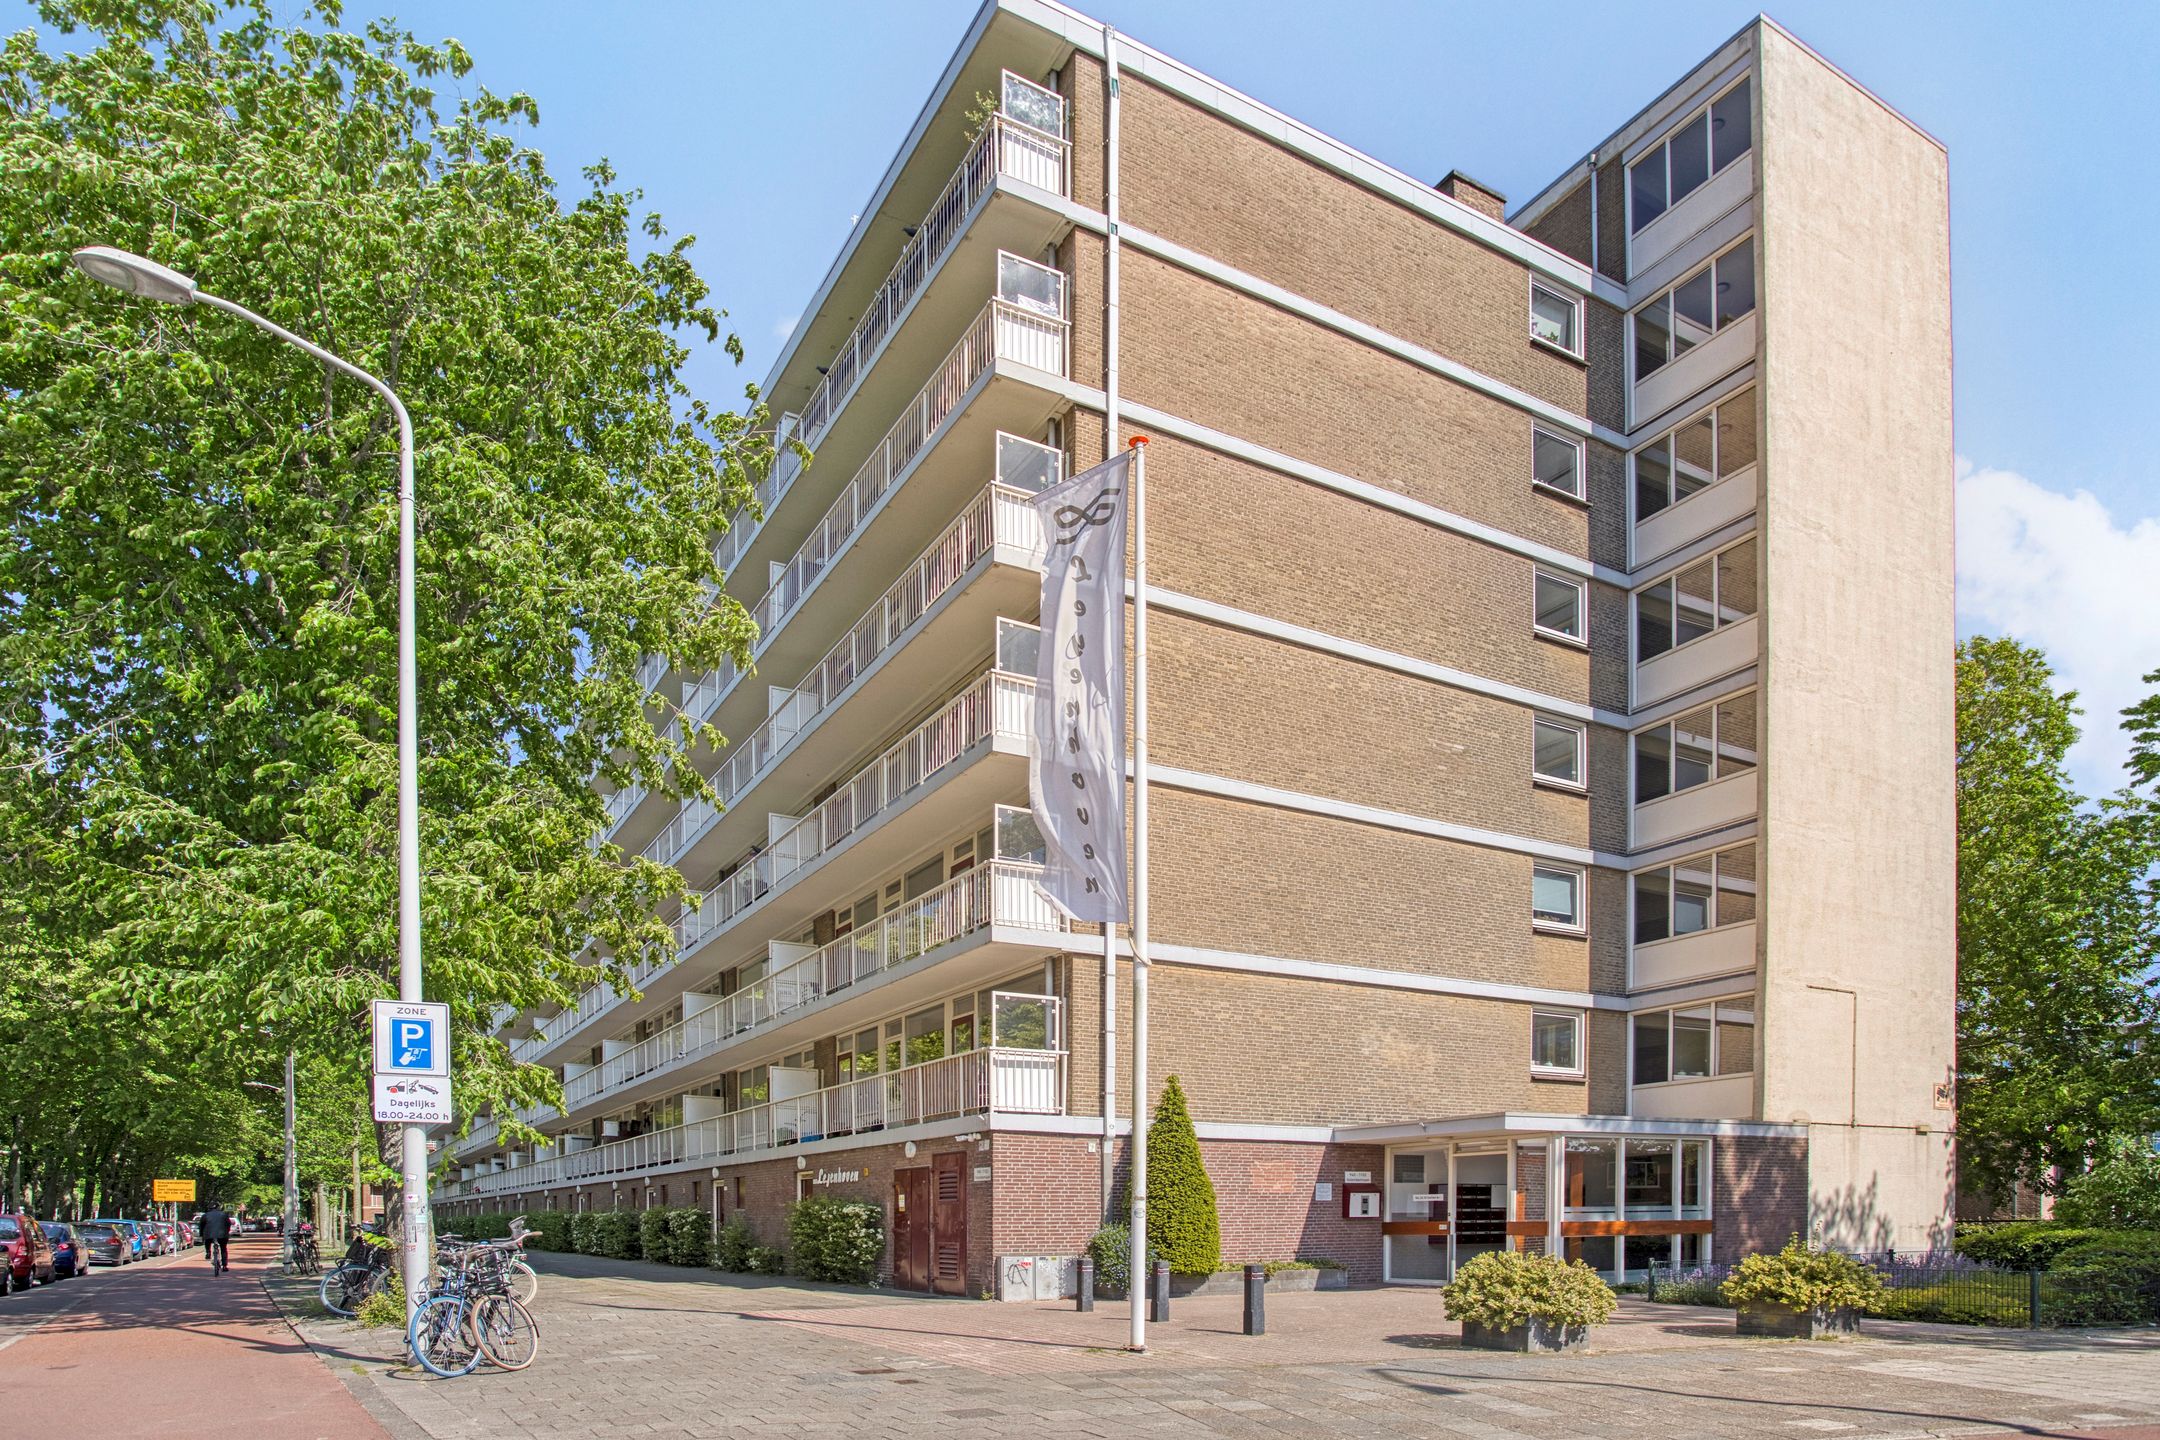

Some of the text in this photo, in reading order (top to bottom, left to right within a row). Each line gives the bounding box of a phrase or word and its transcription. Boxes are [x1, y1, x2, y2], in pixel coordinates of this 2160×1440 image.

[396, 1007, 427, 1016] ZONE
[401, 1023, 424, 1048] P
[390, 1099, 436, 1109] Dagelijks
[377, 1111, 449, 1120] 18.00-24.00 h
